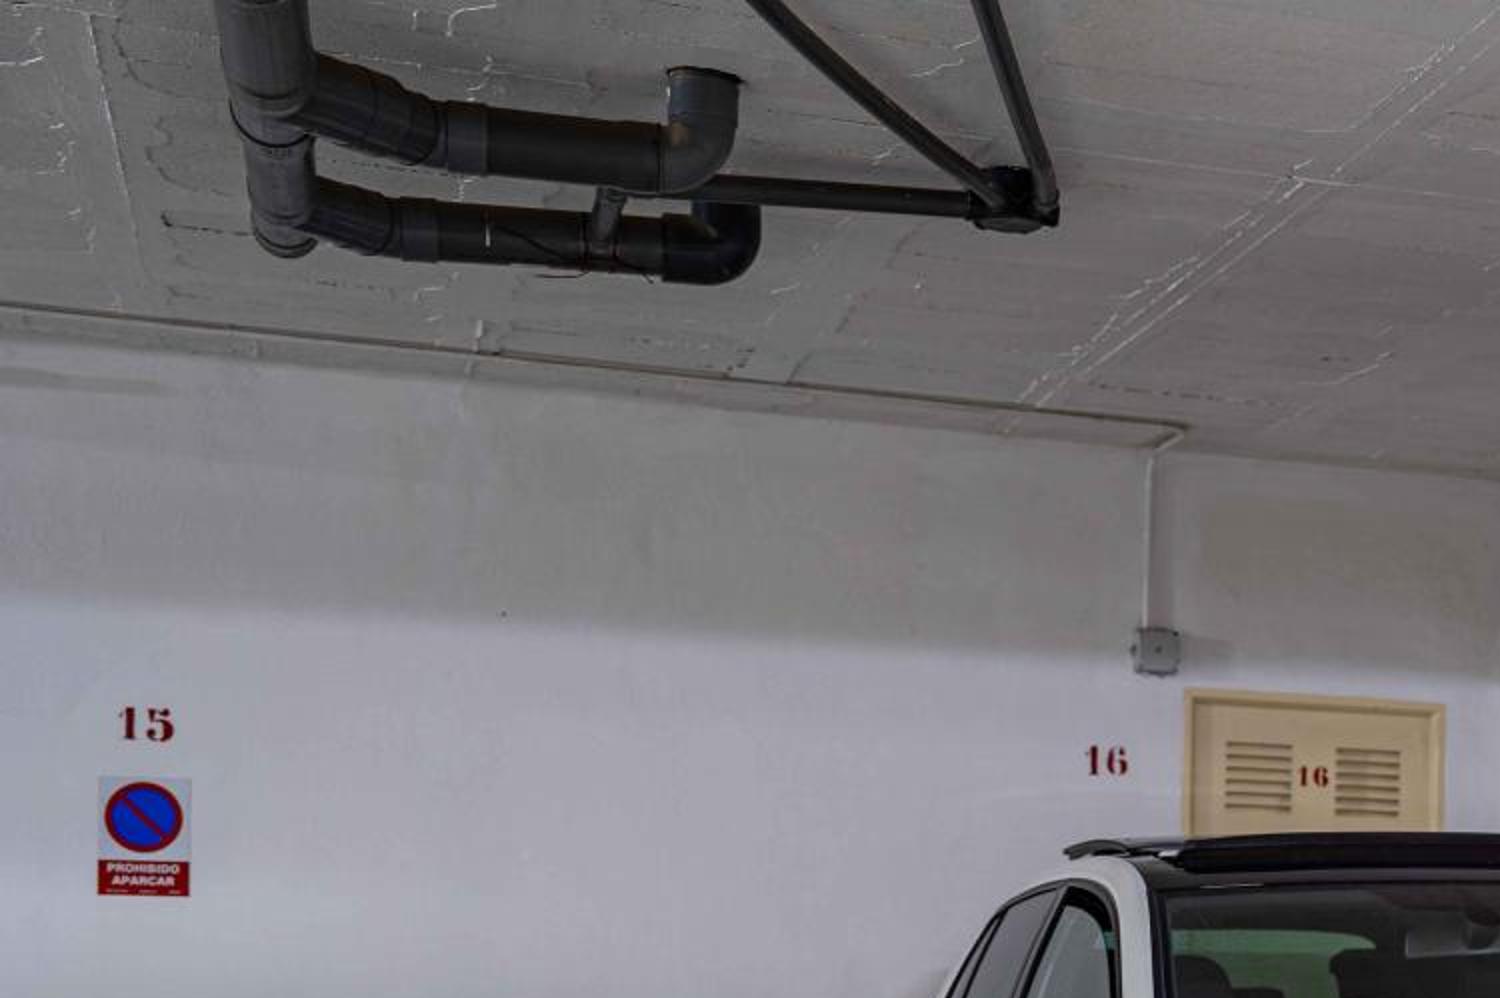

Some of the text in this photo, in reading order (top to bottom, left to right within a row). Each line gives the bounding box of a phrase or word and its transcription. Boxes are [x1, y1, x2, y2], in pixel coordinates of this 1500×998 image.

[118, 706, 175, 742] 15
[1086, 745, 1129, 776] 16
[1299, 766, 1329, 788] 16
[106, 862, 181, 874] PROHIBIDO
[111, 874, 176, 888] APARCAR
